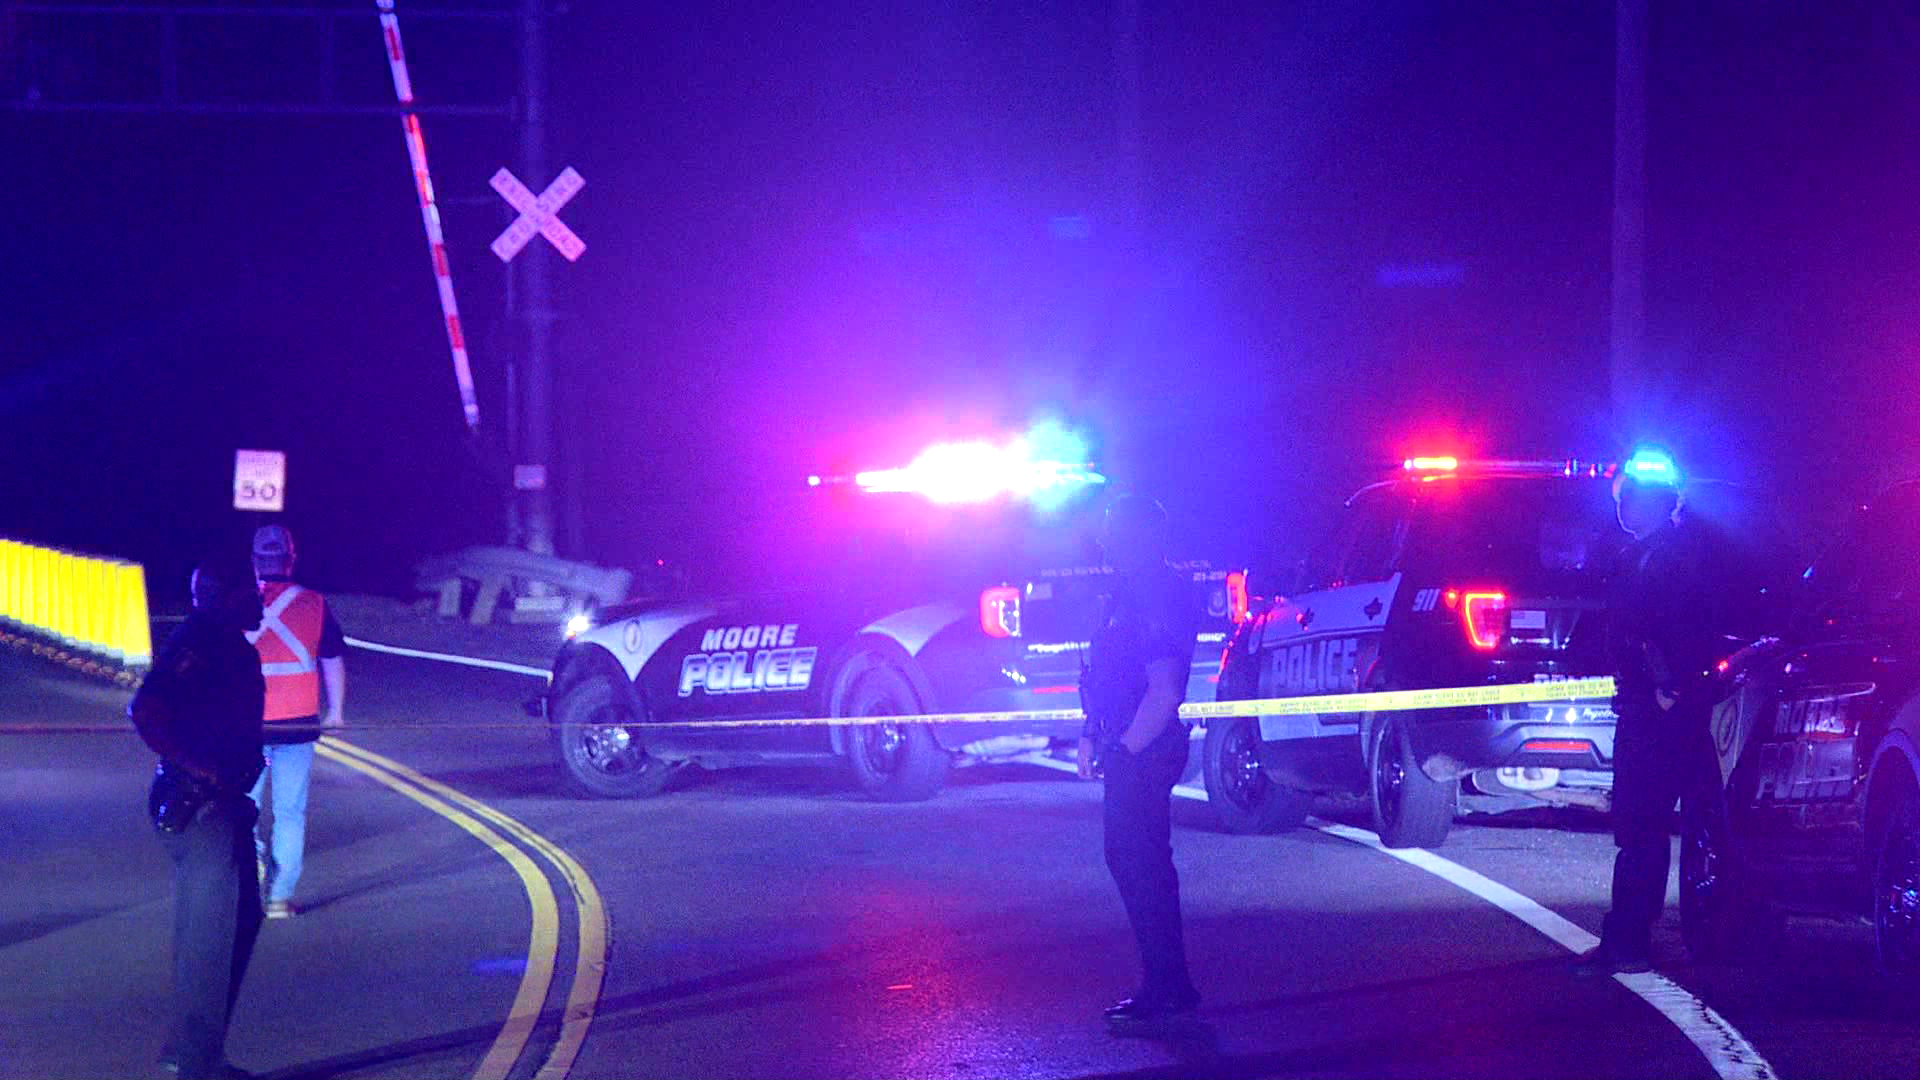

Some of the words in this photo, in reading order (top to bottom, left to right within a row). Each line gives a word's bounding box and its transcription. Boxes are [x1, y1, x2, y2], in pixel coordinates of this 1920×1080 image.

[242, 480, 276, 501] 50
[1411, 588, 1441, 612] 911
[701, 623, 799, 652] MOORE
[678, 646, 818, 697] POLICE
[1271, 639, 1358, 692] POLICE
